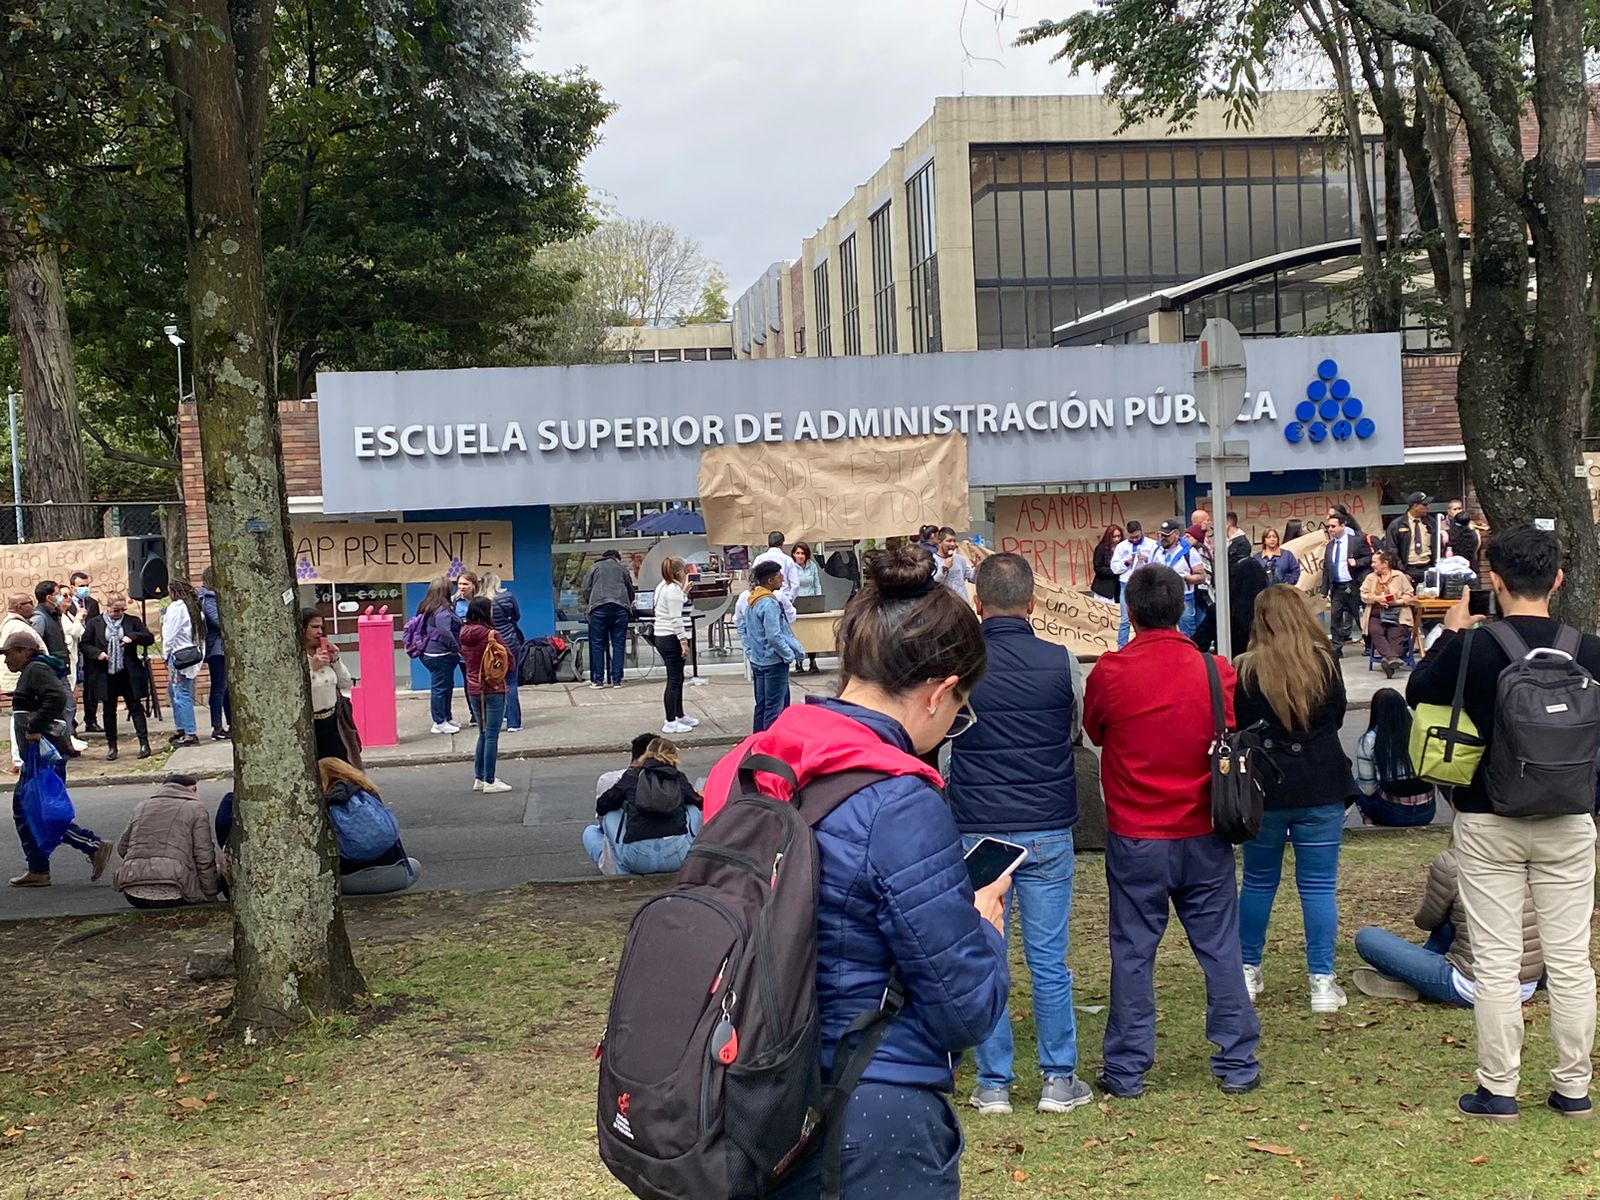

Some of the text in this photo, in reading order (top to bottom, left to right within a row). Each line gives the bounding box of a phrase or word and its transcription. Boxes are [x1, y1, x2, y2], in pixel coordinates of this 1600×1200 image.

[354, 386, 1278, 457] ESCUELA SUPERIOR DE ADMINISTRACIÓN PÚBCA
[1016, 494, 1125, 533] ASAMBLEA
[1246, 501, 1271, 519] LA
[1280, 493, 1366, 519] DEFENSA
[1002, 536, 1100, 586] PERMAN
[1046, 598, 1079, 618] una
